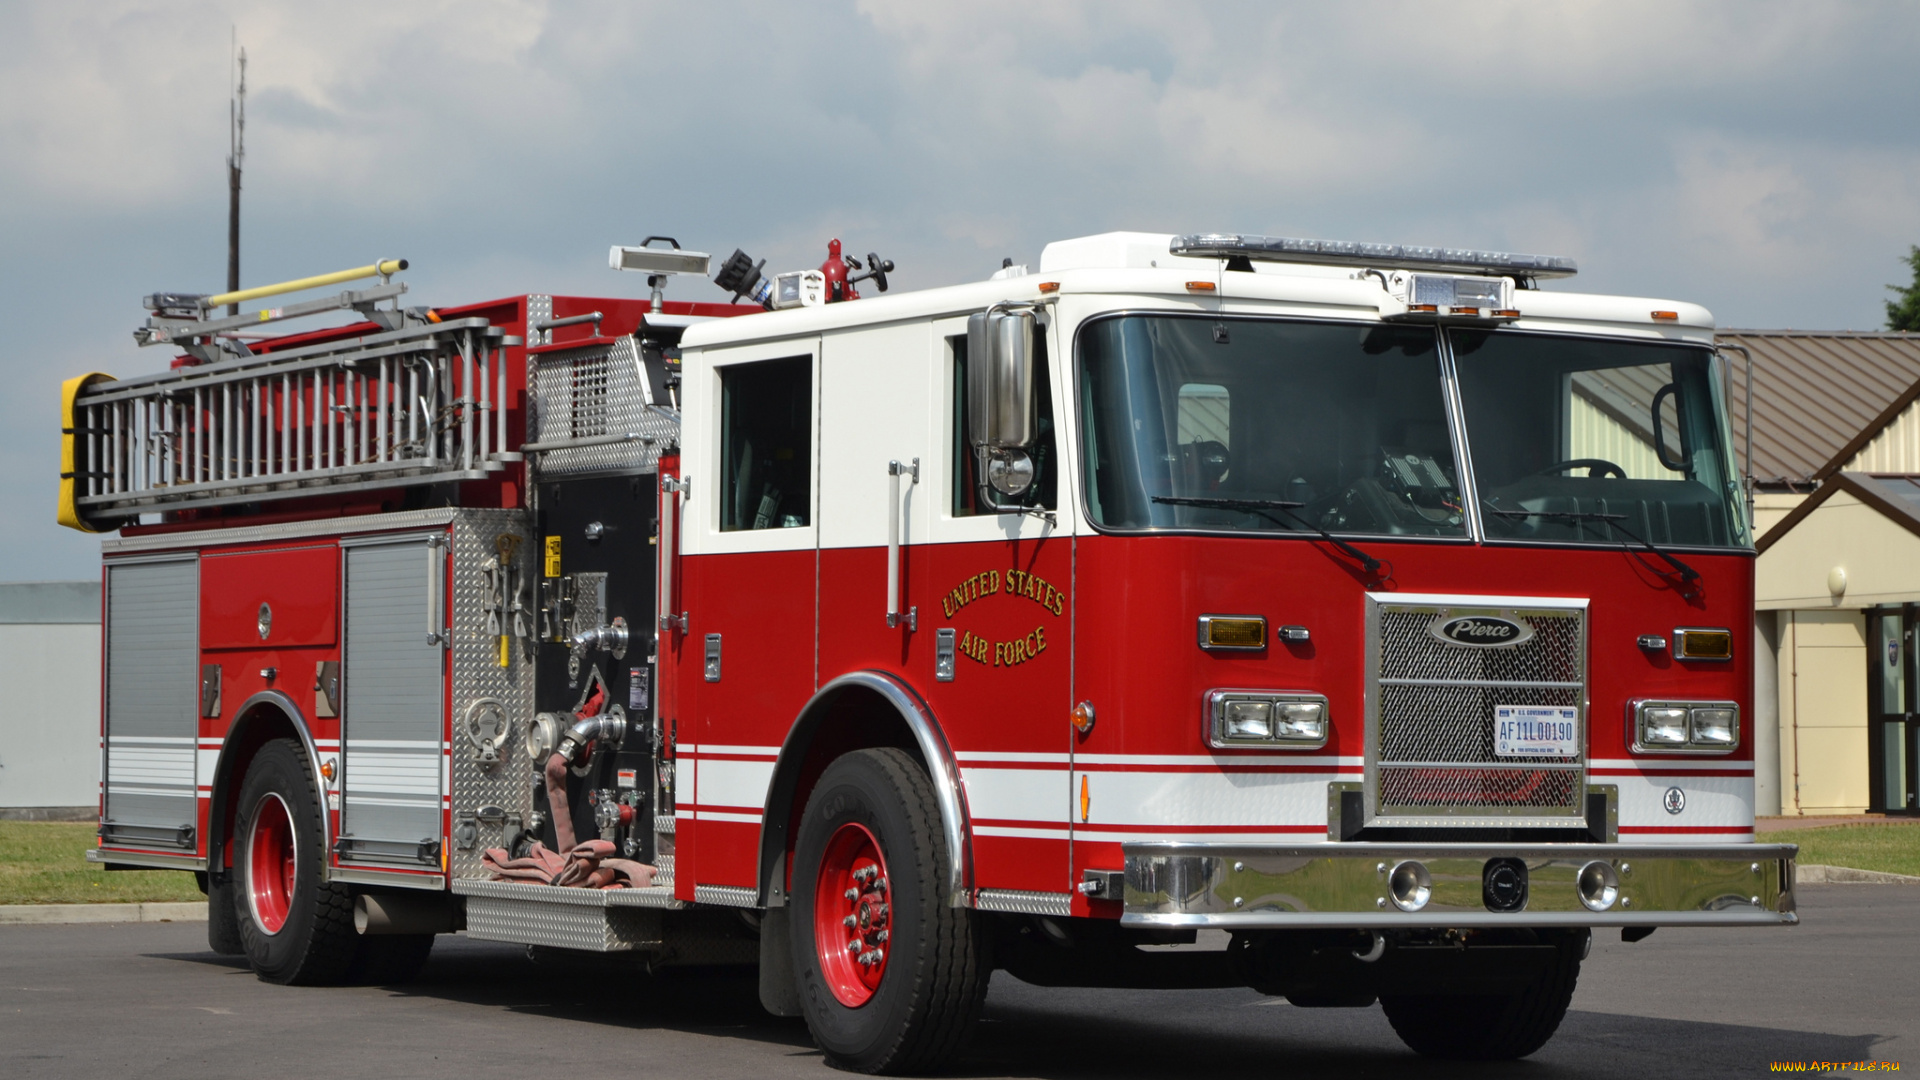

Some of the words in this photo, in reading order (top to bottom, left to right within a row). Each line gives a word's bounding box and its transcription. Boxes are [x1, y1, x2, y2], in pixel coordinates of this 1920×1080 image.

[942, 569, 1000, 619] UNITED
[1005, 568, 1065, 616] STATES
[1451, 619, 1510, 638] Pierce
[959, 630, 988, 664] AIR
[994, 625, 1047, 667] FORCE
[1500, 721, 1572, 740] AF11L00190
